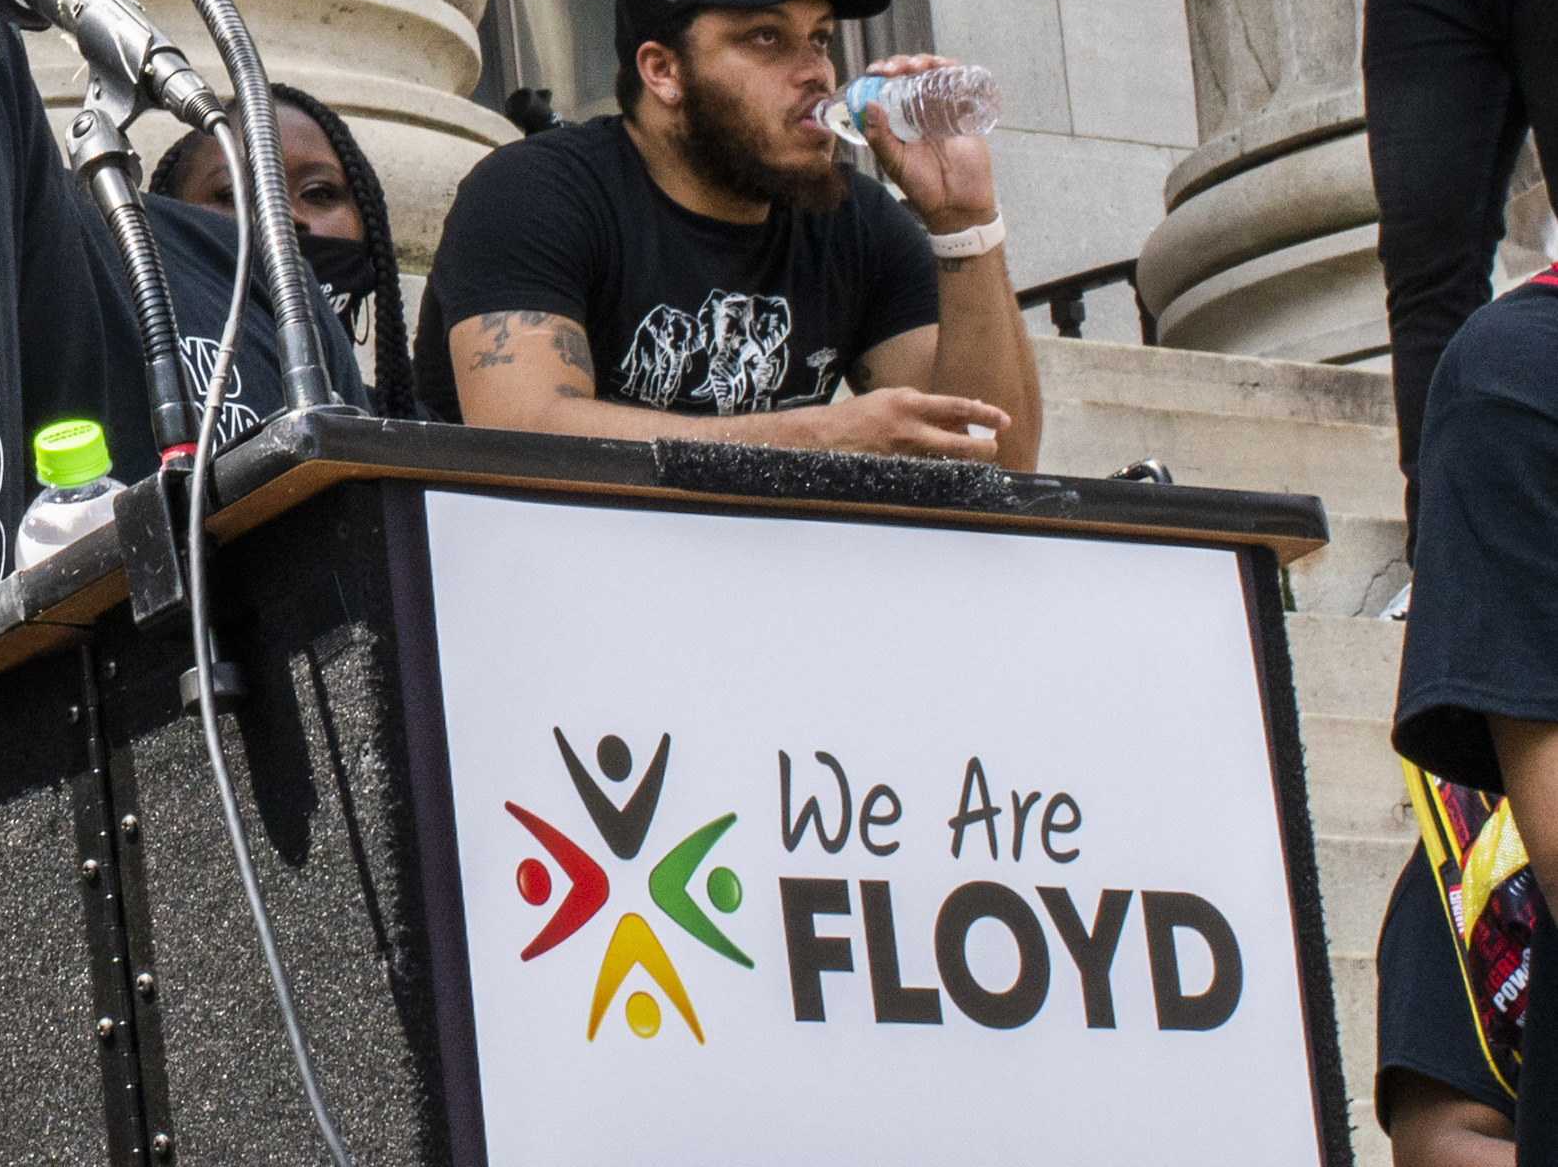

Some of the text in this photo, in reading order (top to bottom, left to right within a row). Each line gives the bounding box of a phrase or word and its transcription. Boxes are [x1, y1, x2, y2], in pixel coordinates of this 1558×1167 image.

[778, 749, 1082, 864] We Are
[779, 875, 1243, 1032] FLOYD
